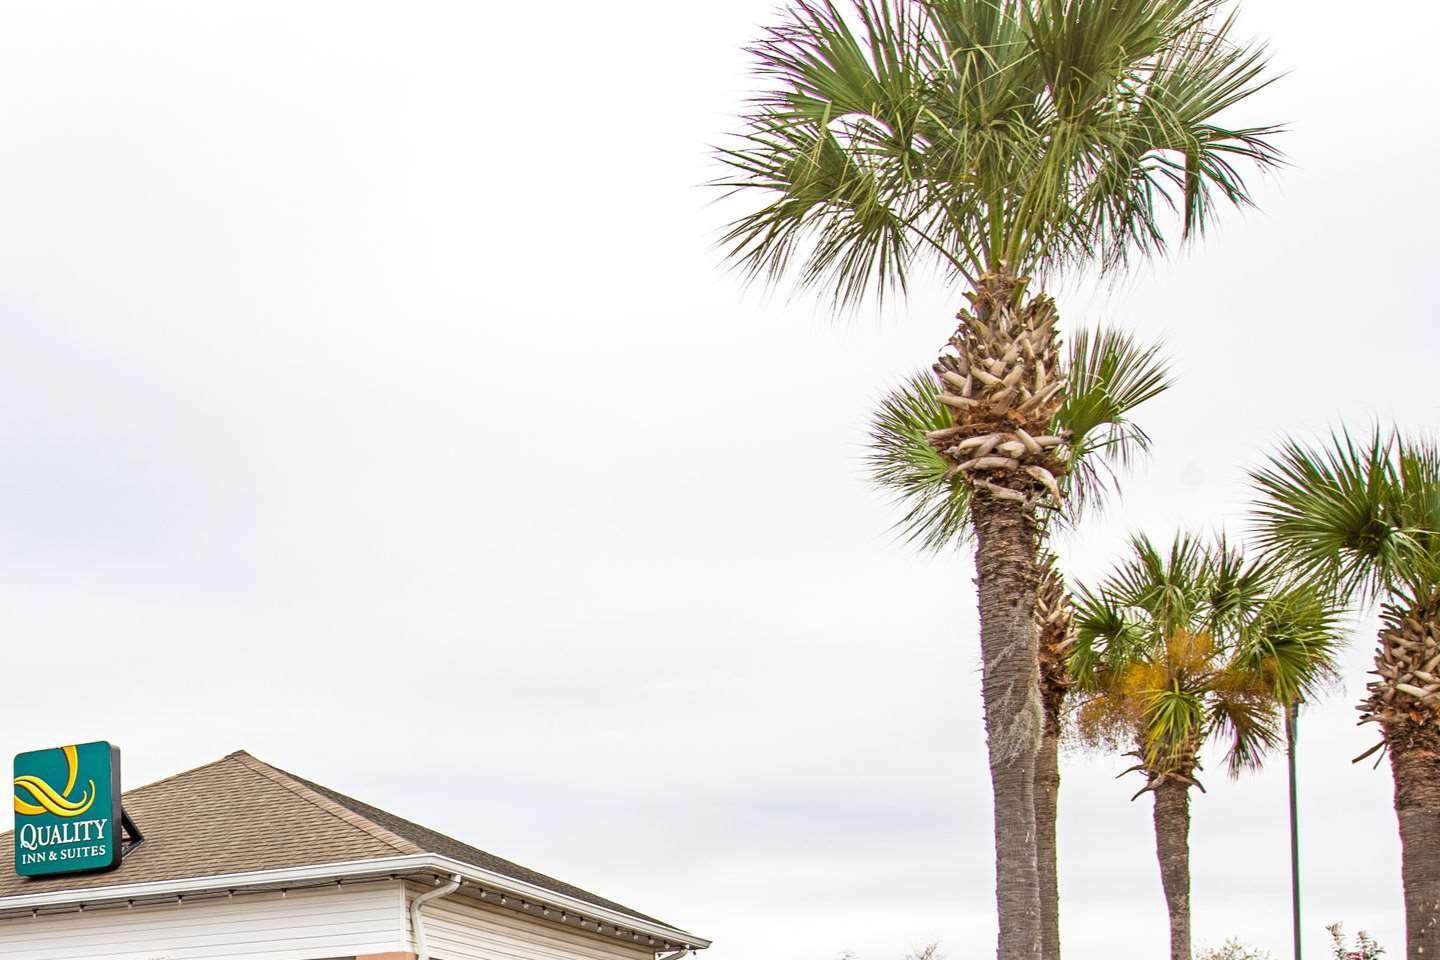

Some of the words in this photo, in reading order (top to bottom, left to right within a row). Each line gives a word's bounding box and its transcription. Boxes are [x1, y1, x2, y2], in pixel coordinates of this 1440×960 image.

[20, 818, 107, 851] QUALITY
[22, 851, 46, 865] INN
[48, 850, 58, 861] &
[60, 844, 106, 860] SUITES
